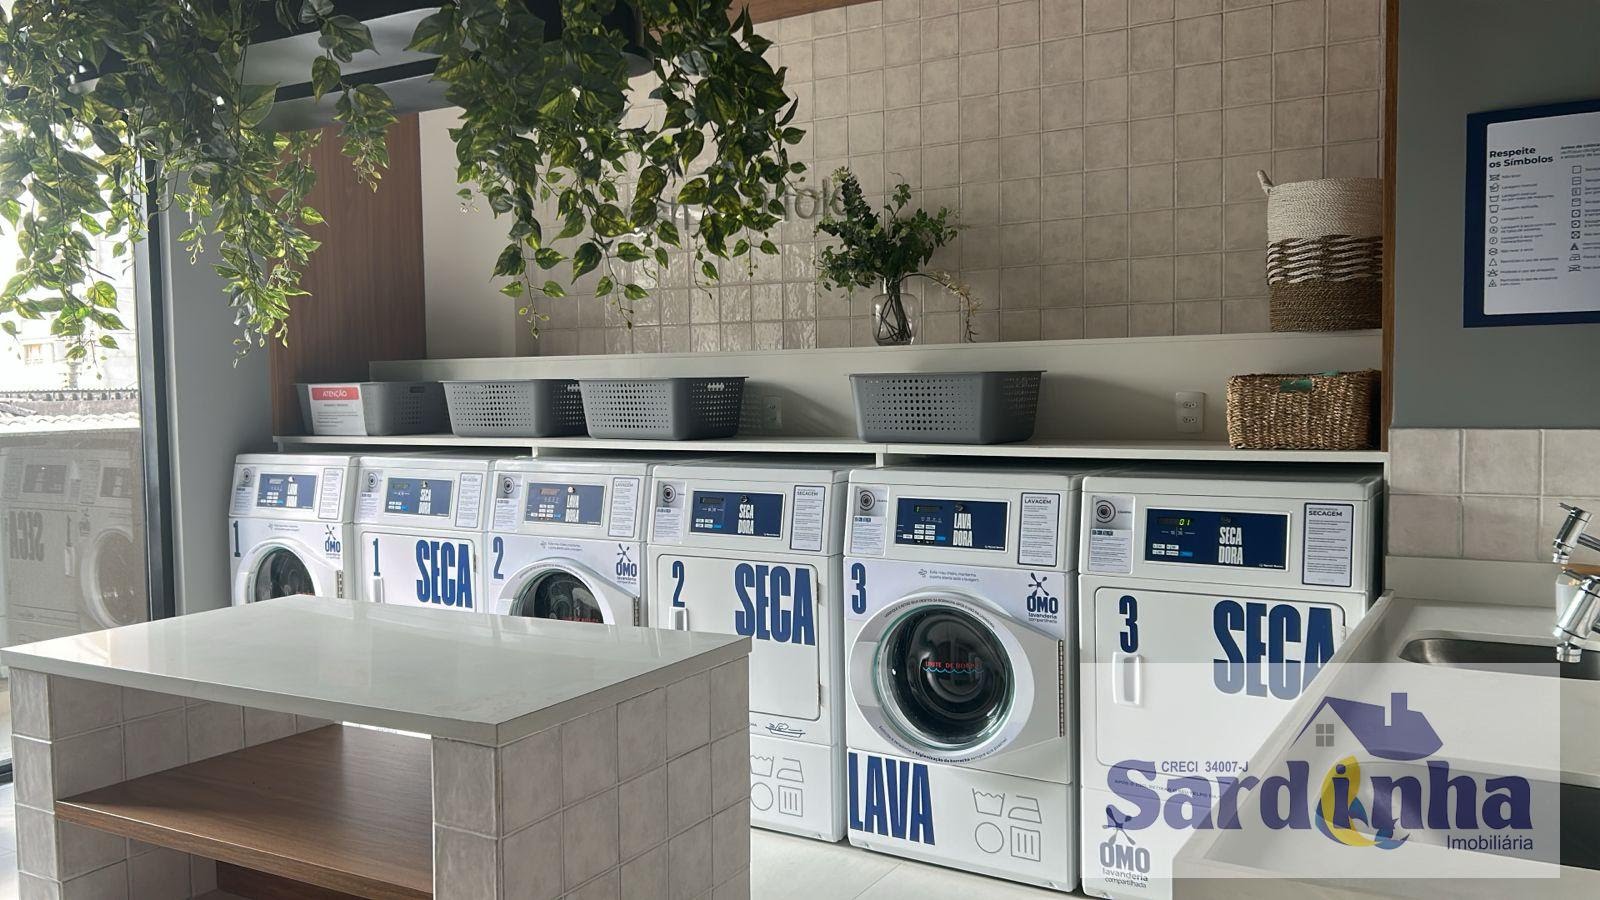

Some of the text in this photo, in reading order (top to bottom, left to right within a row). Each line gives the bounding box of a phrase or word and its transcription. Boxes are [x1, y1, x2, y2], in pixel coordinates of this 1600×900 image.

[1489, 147, 1536, 158] Respeite
[1503, 156, 1554, 167] Símbolos
[739, 504, 754, 519] SECA
[954, 513, 972, 530] LAVA
[1179, 518, 1191, 526] 01
[233, 520, 241, 557] 1
[952, 530, 973, 547] DORA
[1218, 526, 1243, 546] SECA
[325, 541, 341, 553] OMO
[1217, 546, 1244, 565] DORA
[372, 538, 381, 576] 1
[493, 536, 504, 580] 2
[416, 539, 473, 609] SECA
[615, 562, 637, 577] OMO
[672, 560, 686, 608] 2
[851, 562, 867, 615] 3
[734, 563, 816, 646] SECA
[1026, 595, 1059, 614] OMO
[1028, 612, 1058, 620] lavanderia
[1119, 595, 1139, 653] 3
[1213, 600, 1336, 700] SECA
[848, 751, 935, 846] LAVA
[1099, 842, 1151, 874] OMO
[1102, 867, 1149, 882] lavanderia
[1104, 876, 1147, 889] compartilhada
